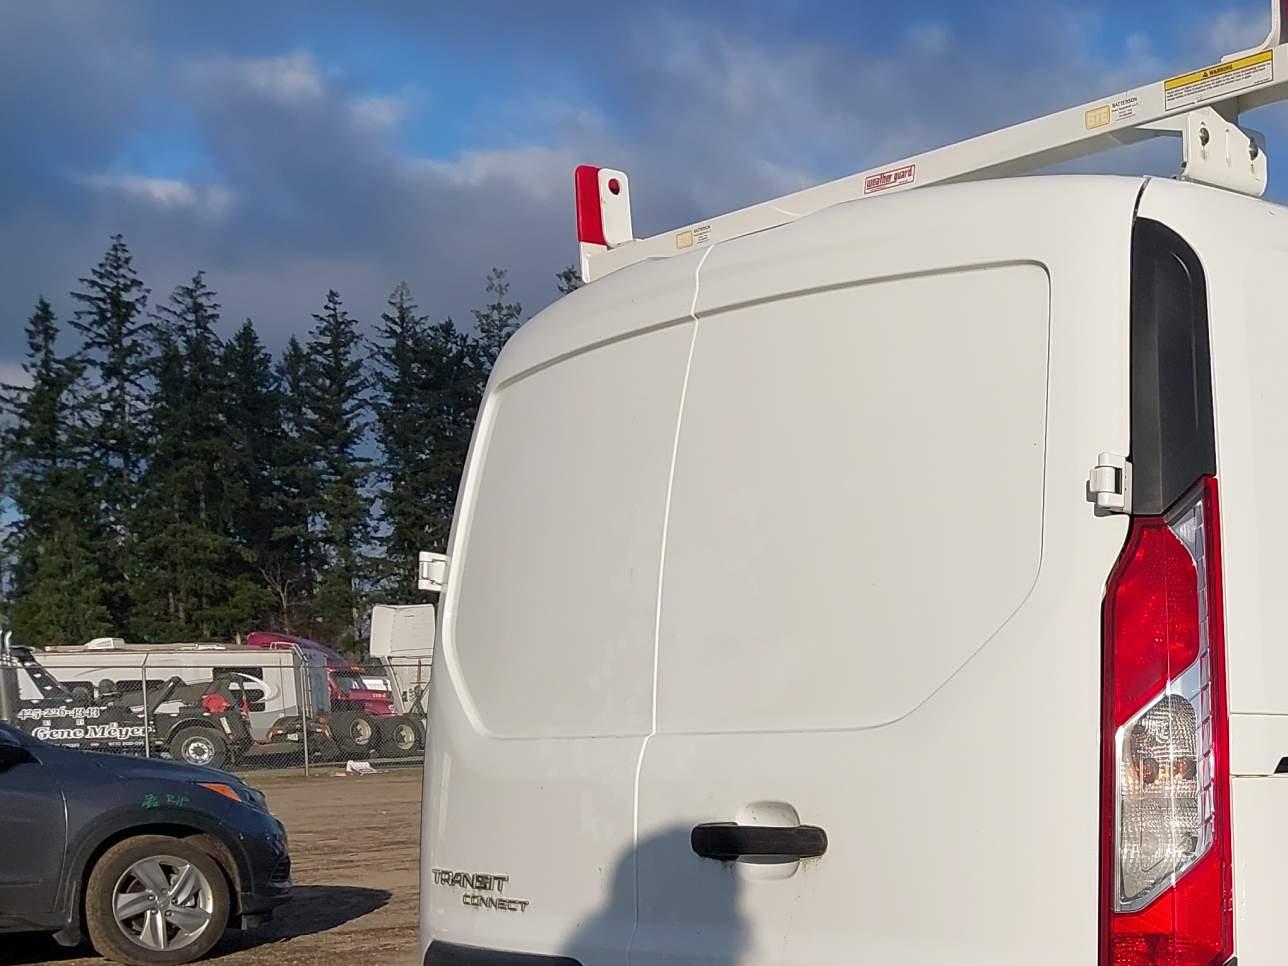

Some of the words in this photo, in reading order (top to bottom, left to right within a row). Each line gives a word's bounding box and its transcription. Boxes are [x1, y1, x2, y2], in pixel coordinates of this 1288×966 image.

[32, 727, 85, 740] Gene
[432, 869, 510, 893] TRANSIT
[462, 894, 530, 913] CONNECT
